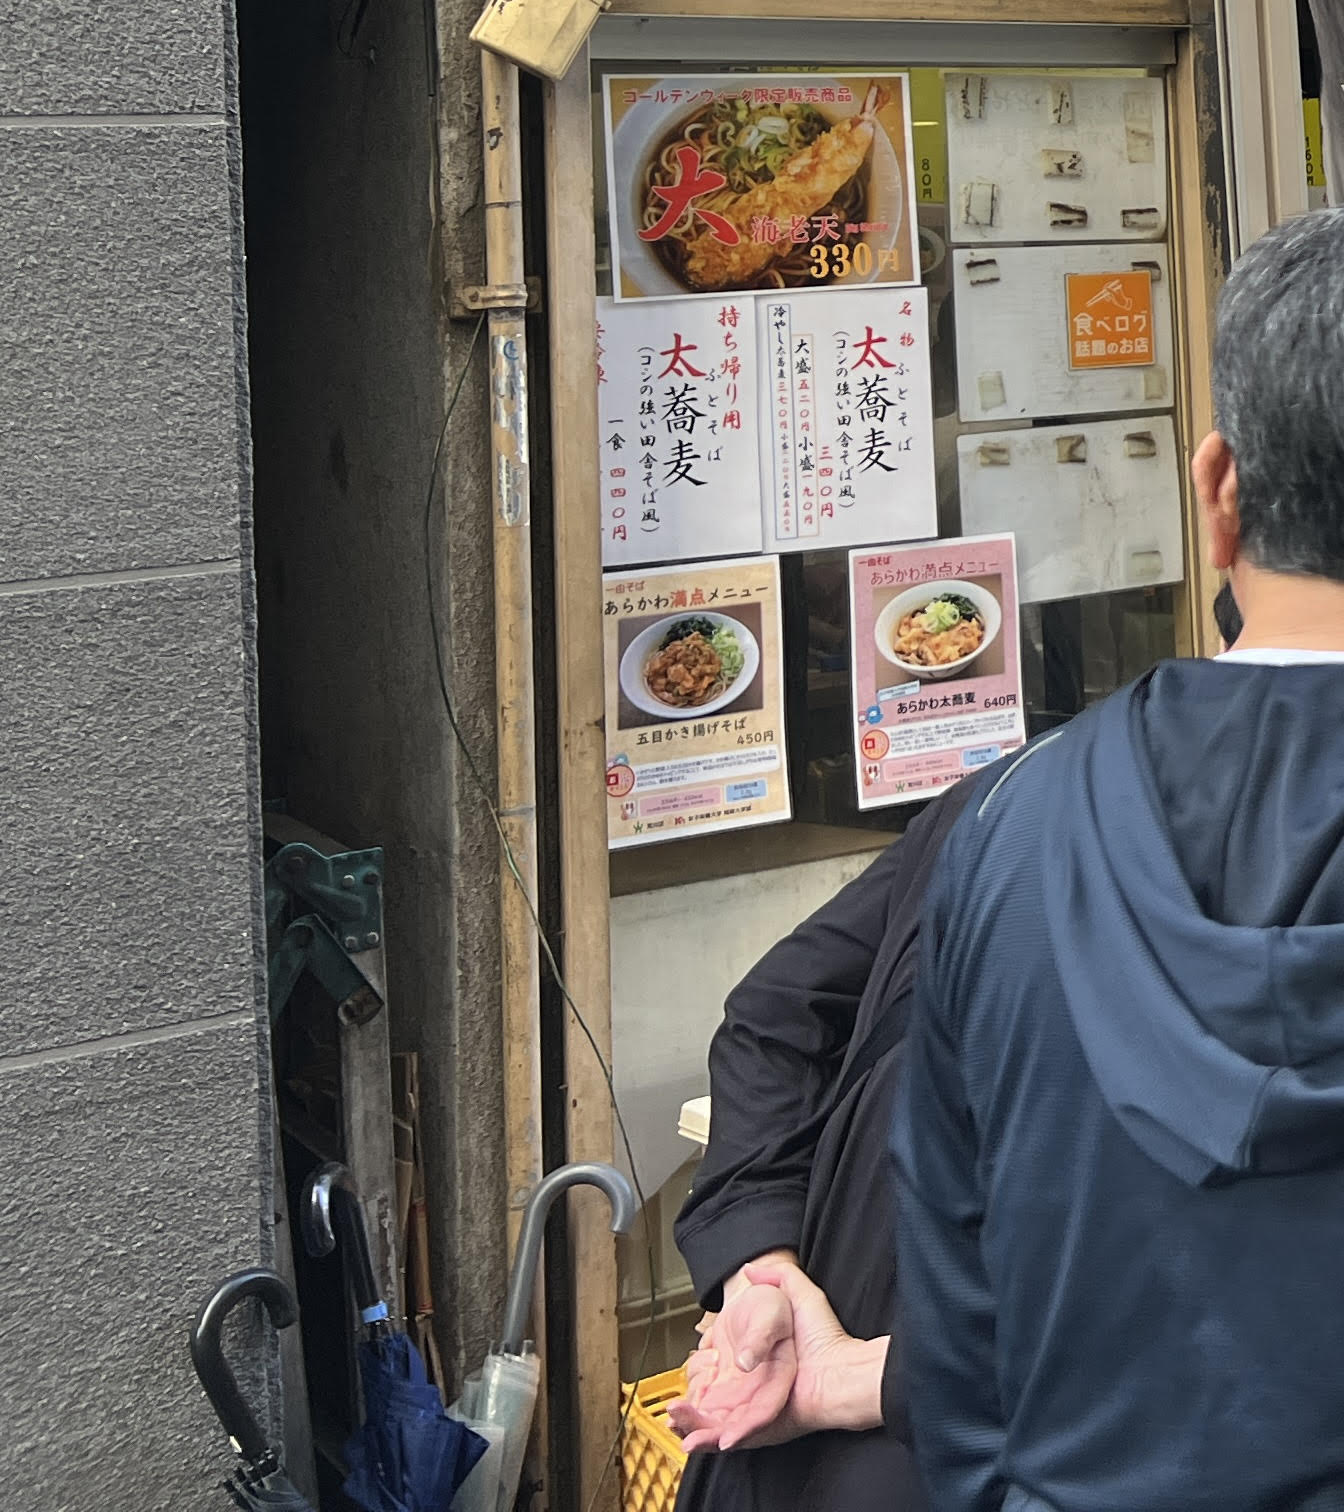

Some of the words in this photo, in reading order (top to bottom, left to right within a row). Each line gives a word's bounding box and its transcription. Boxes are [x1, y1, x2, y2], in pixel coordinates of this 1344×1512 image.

[638, 145, 742, 247] 大
[751, 213, 841, 244] 海老天
[809, 242, 899, 279] 330円
[899, 301, 914, 347] 名物
[1073, 311, 1148, 336] 食べログ
[1075, 337, 1149, 357] 話題のお店
[718, 305, 742, 431] 持ち帰り用
[657, 332, 709, 487] 太蕎麦
[705, 368, 723, 462] ふとそば
[851, 326, 899, 473] 太蕎麦
[895, 361, 912, 452] ふとそば
[870, 561, 999, 586] あらかわ満点メニュー
[604, 586, 769, 616] あらかわ満点メニュー
[897, 692, 976, 715] あらかわ太蕎麦
[984, 694, 1017, 709] 640円
[637, 717, 748, 746] 五目かき揚げそば
[736, 730, 775, 745] 450円
